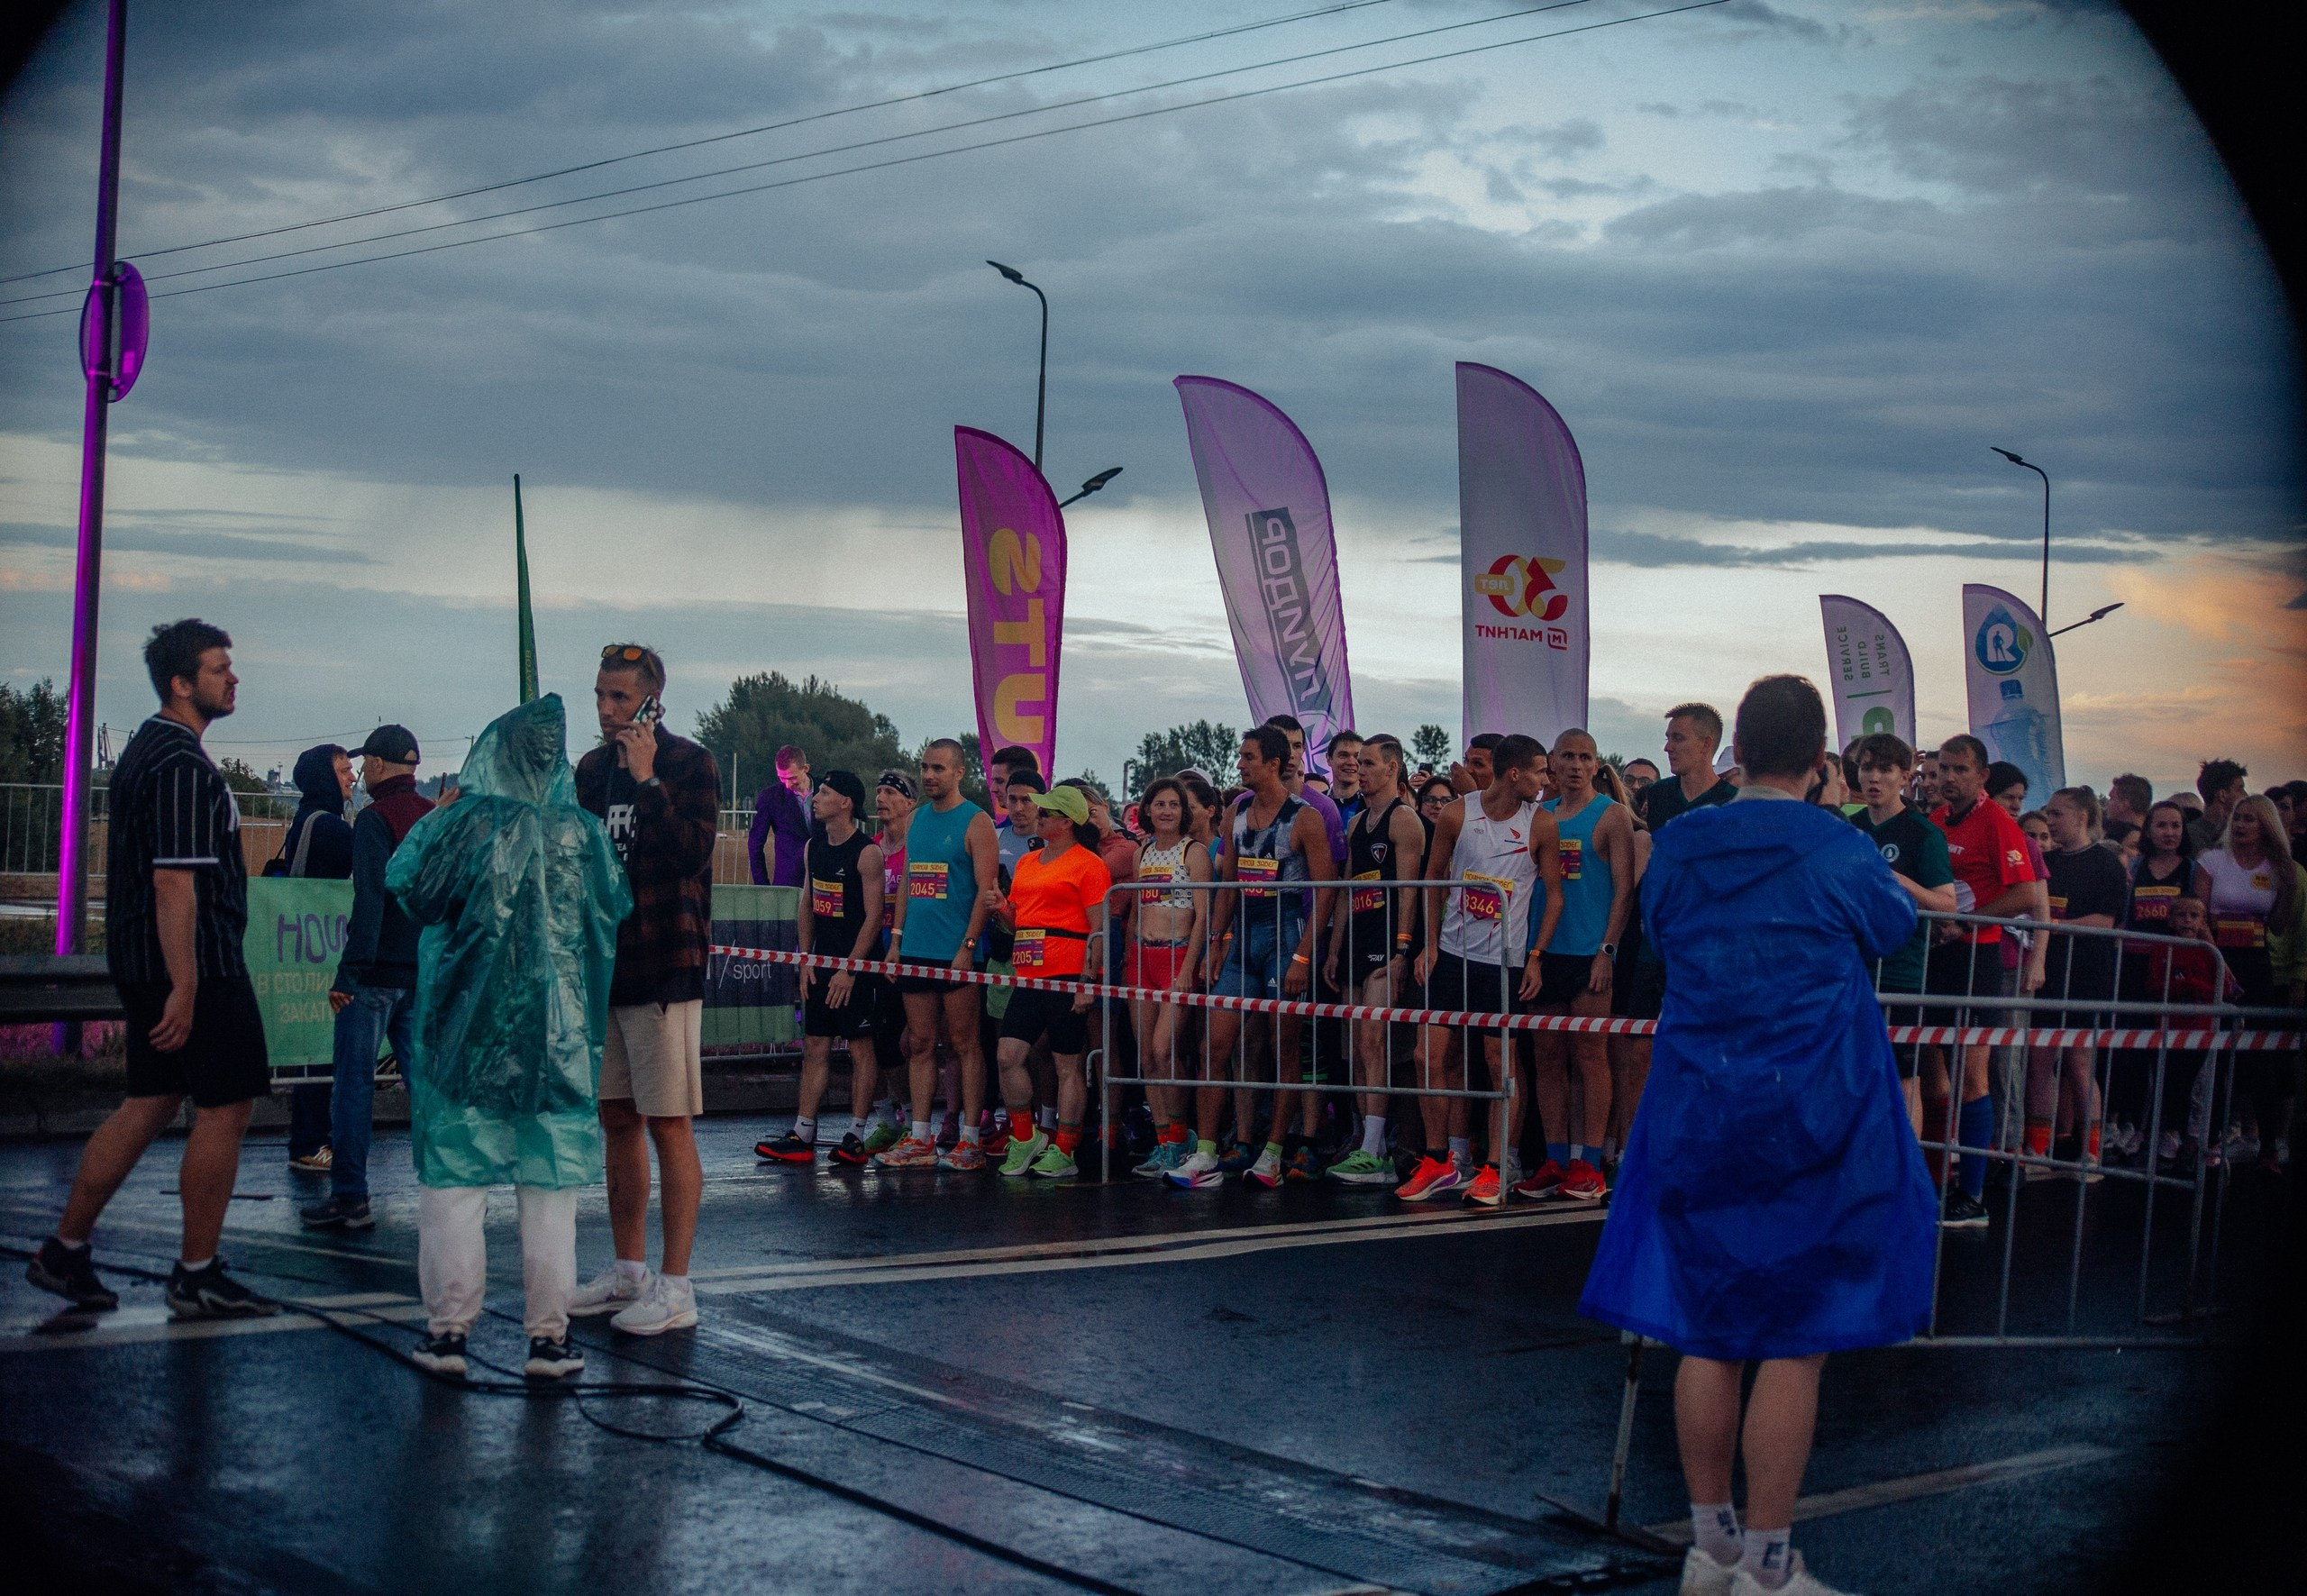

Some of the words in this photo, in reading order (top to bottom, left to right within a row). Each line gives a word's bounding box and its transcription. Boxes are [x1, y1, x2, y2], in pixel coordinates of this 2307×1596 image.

[525, 650, 534, 701] АКАТОВ
[910, 882, 935, 896] 2045
[278, 913, 350, 964] НОЧ
[1012, 950, 1032, 965] 2205
[733, 961, 772, 984] sport
